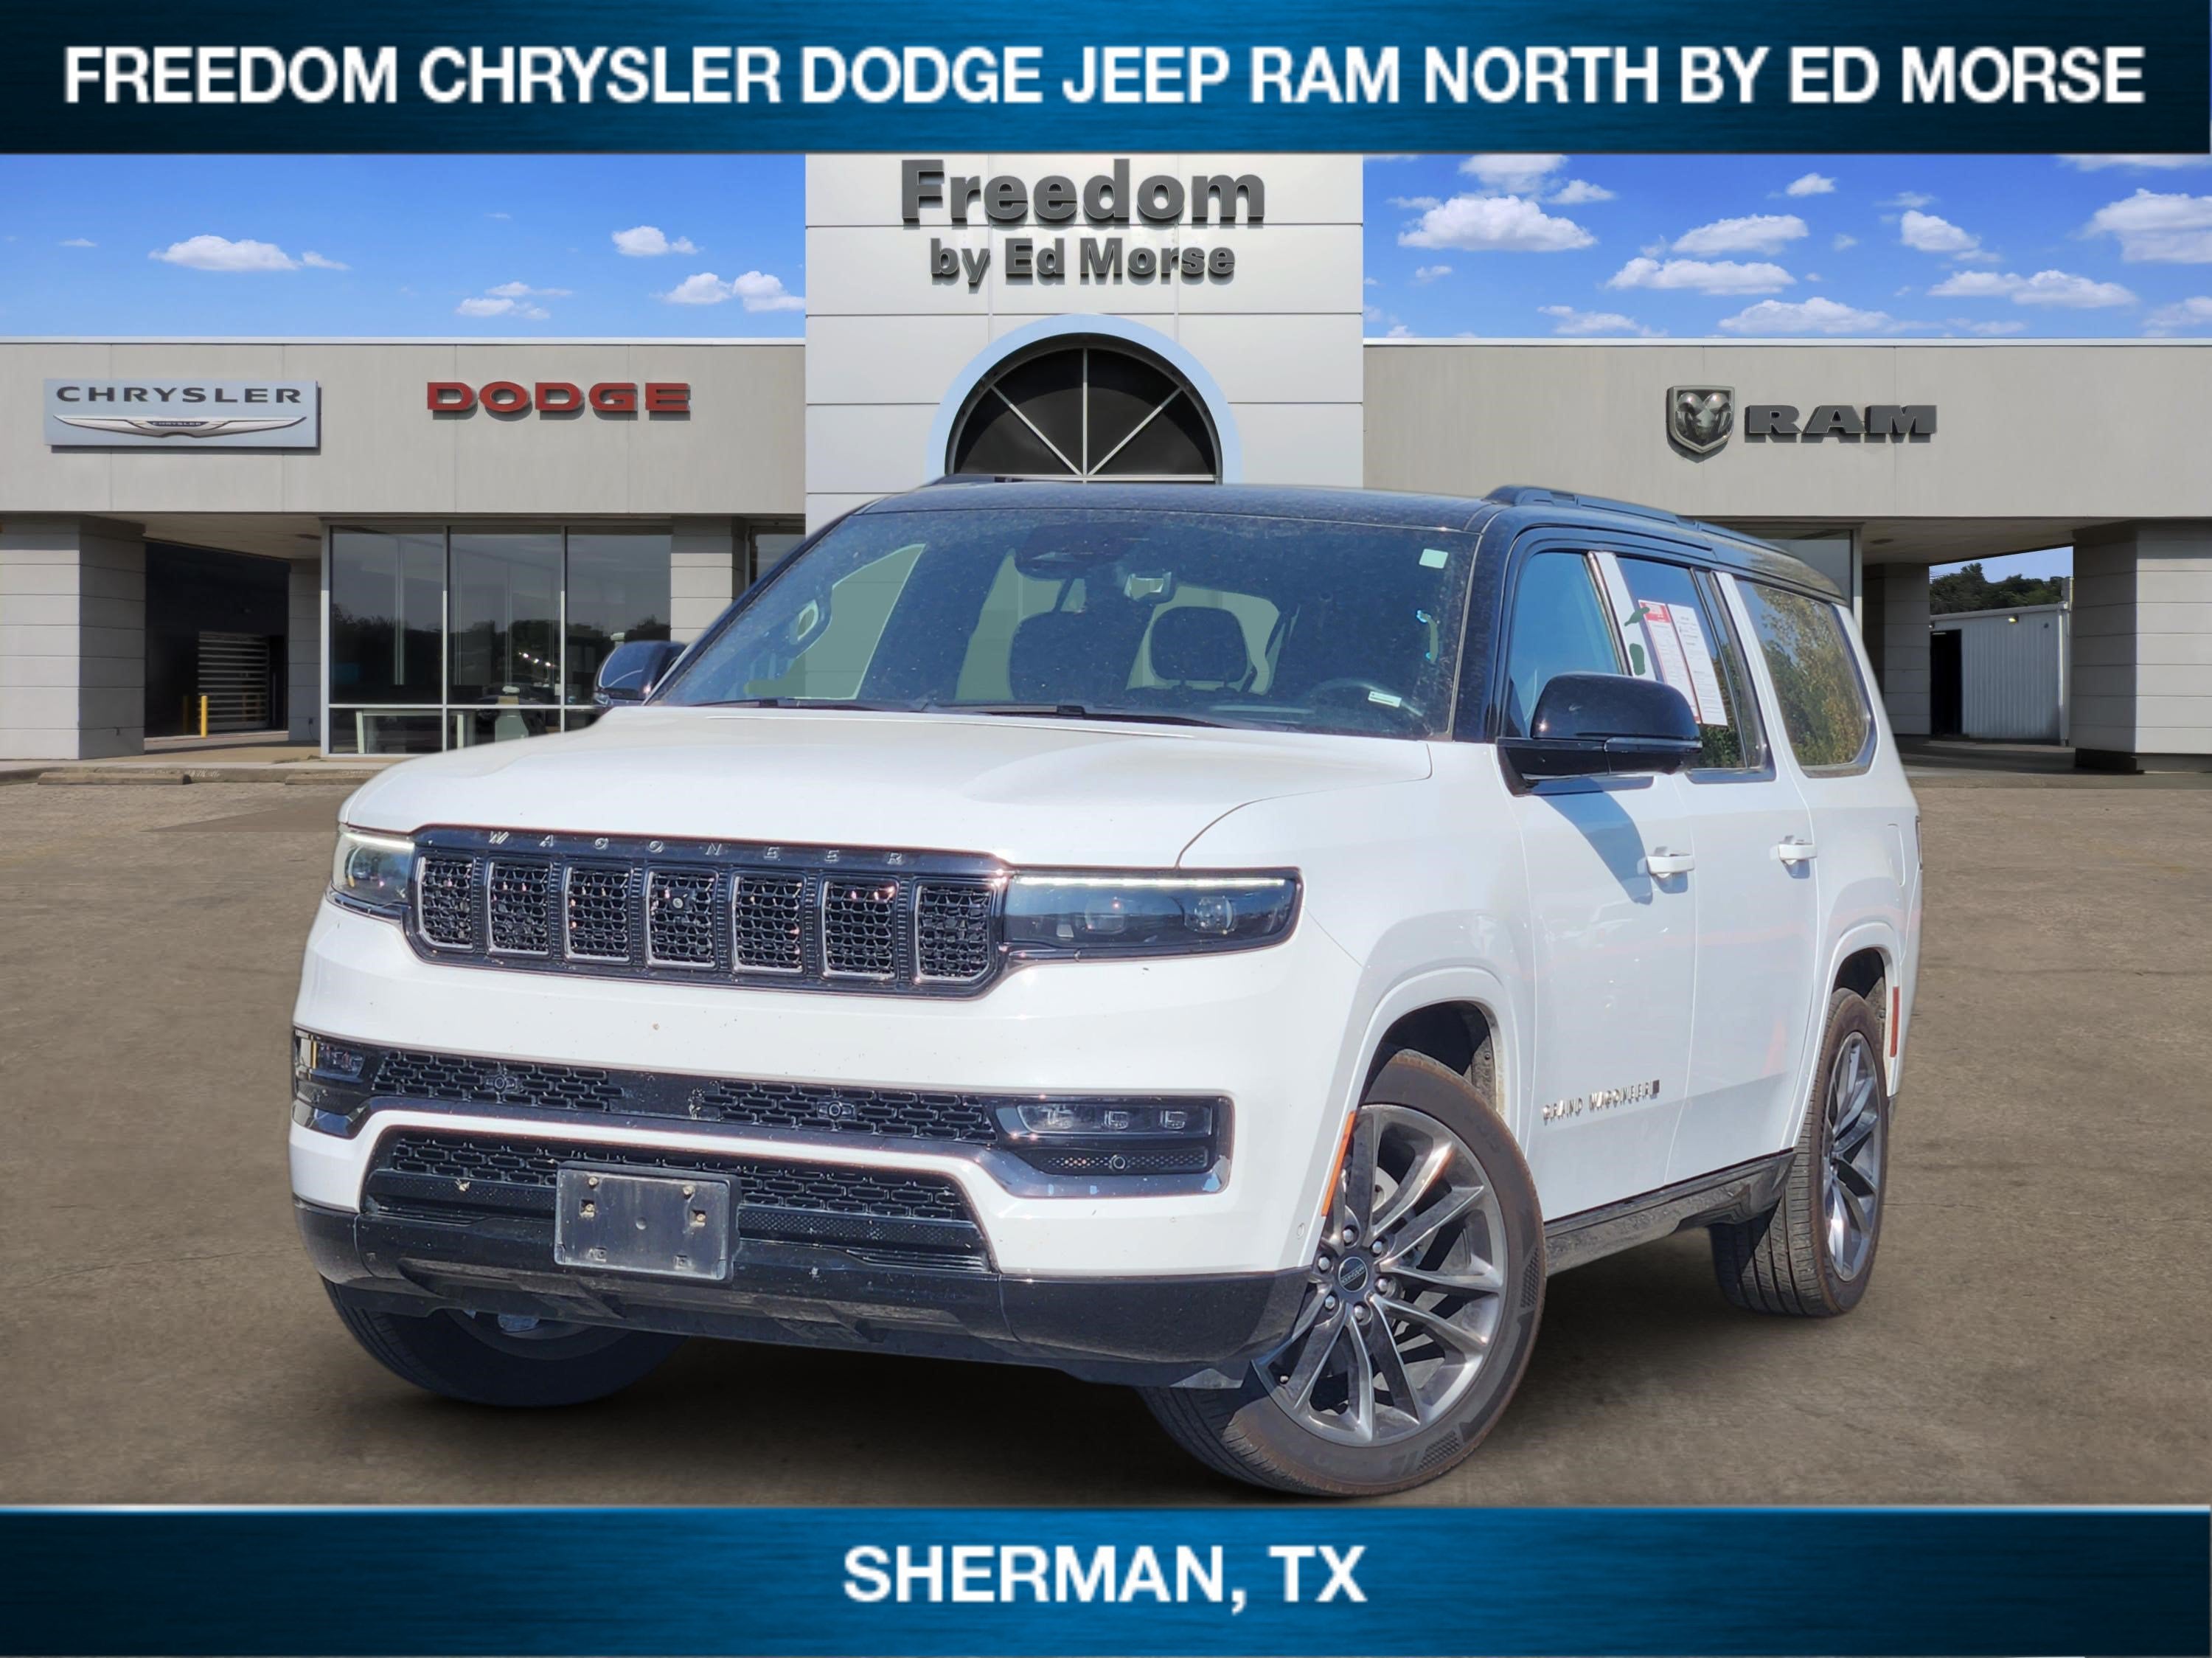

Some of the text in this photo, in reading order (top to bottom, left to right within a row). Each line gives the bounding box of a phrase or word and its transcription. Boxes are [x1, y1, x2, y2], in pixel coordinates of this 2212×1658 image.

[901, 158, 1266, 223] Freedom
[931, 237, 1236, 286] by Ed Morse
[56, 386, 301, 403] CHRYSLER
[427, 381, 690, 412] DODGE
[1745, 404, 1938, 434] RAM
[489, 830, 903, 866] WAGONEER
